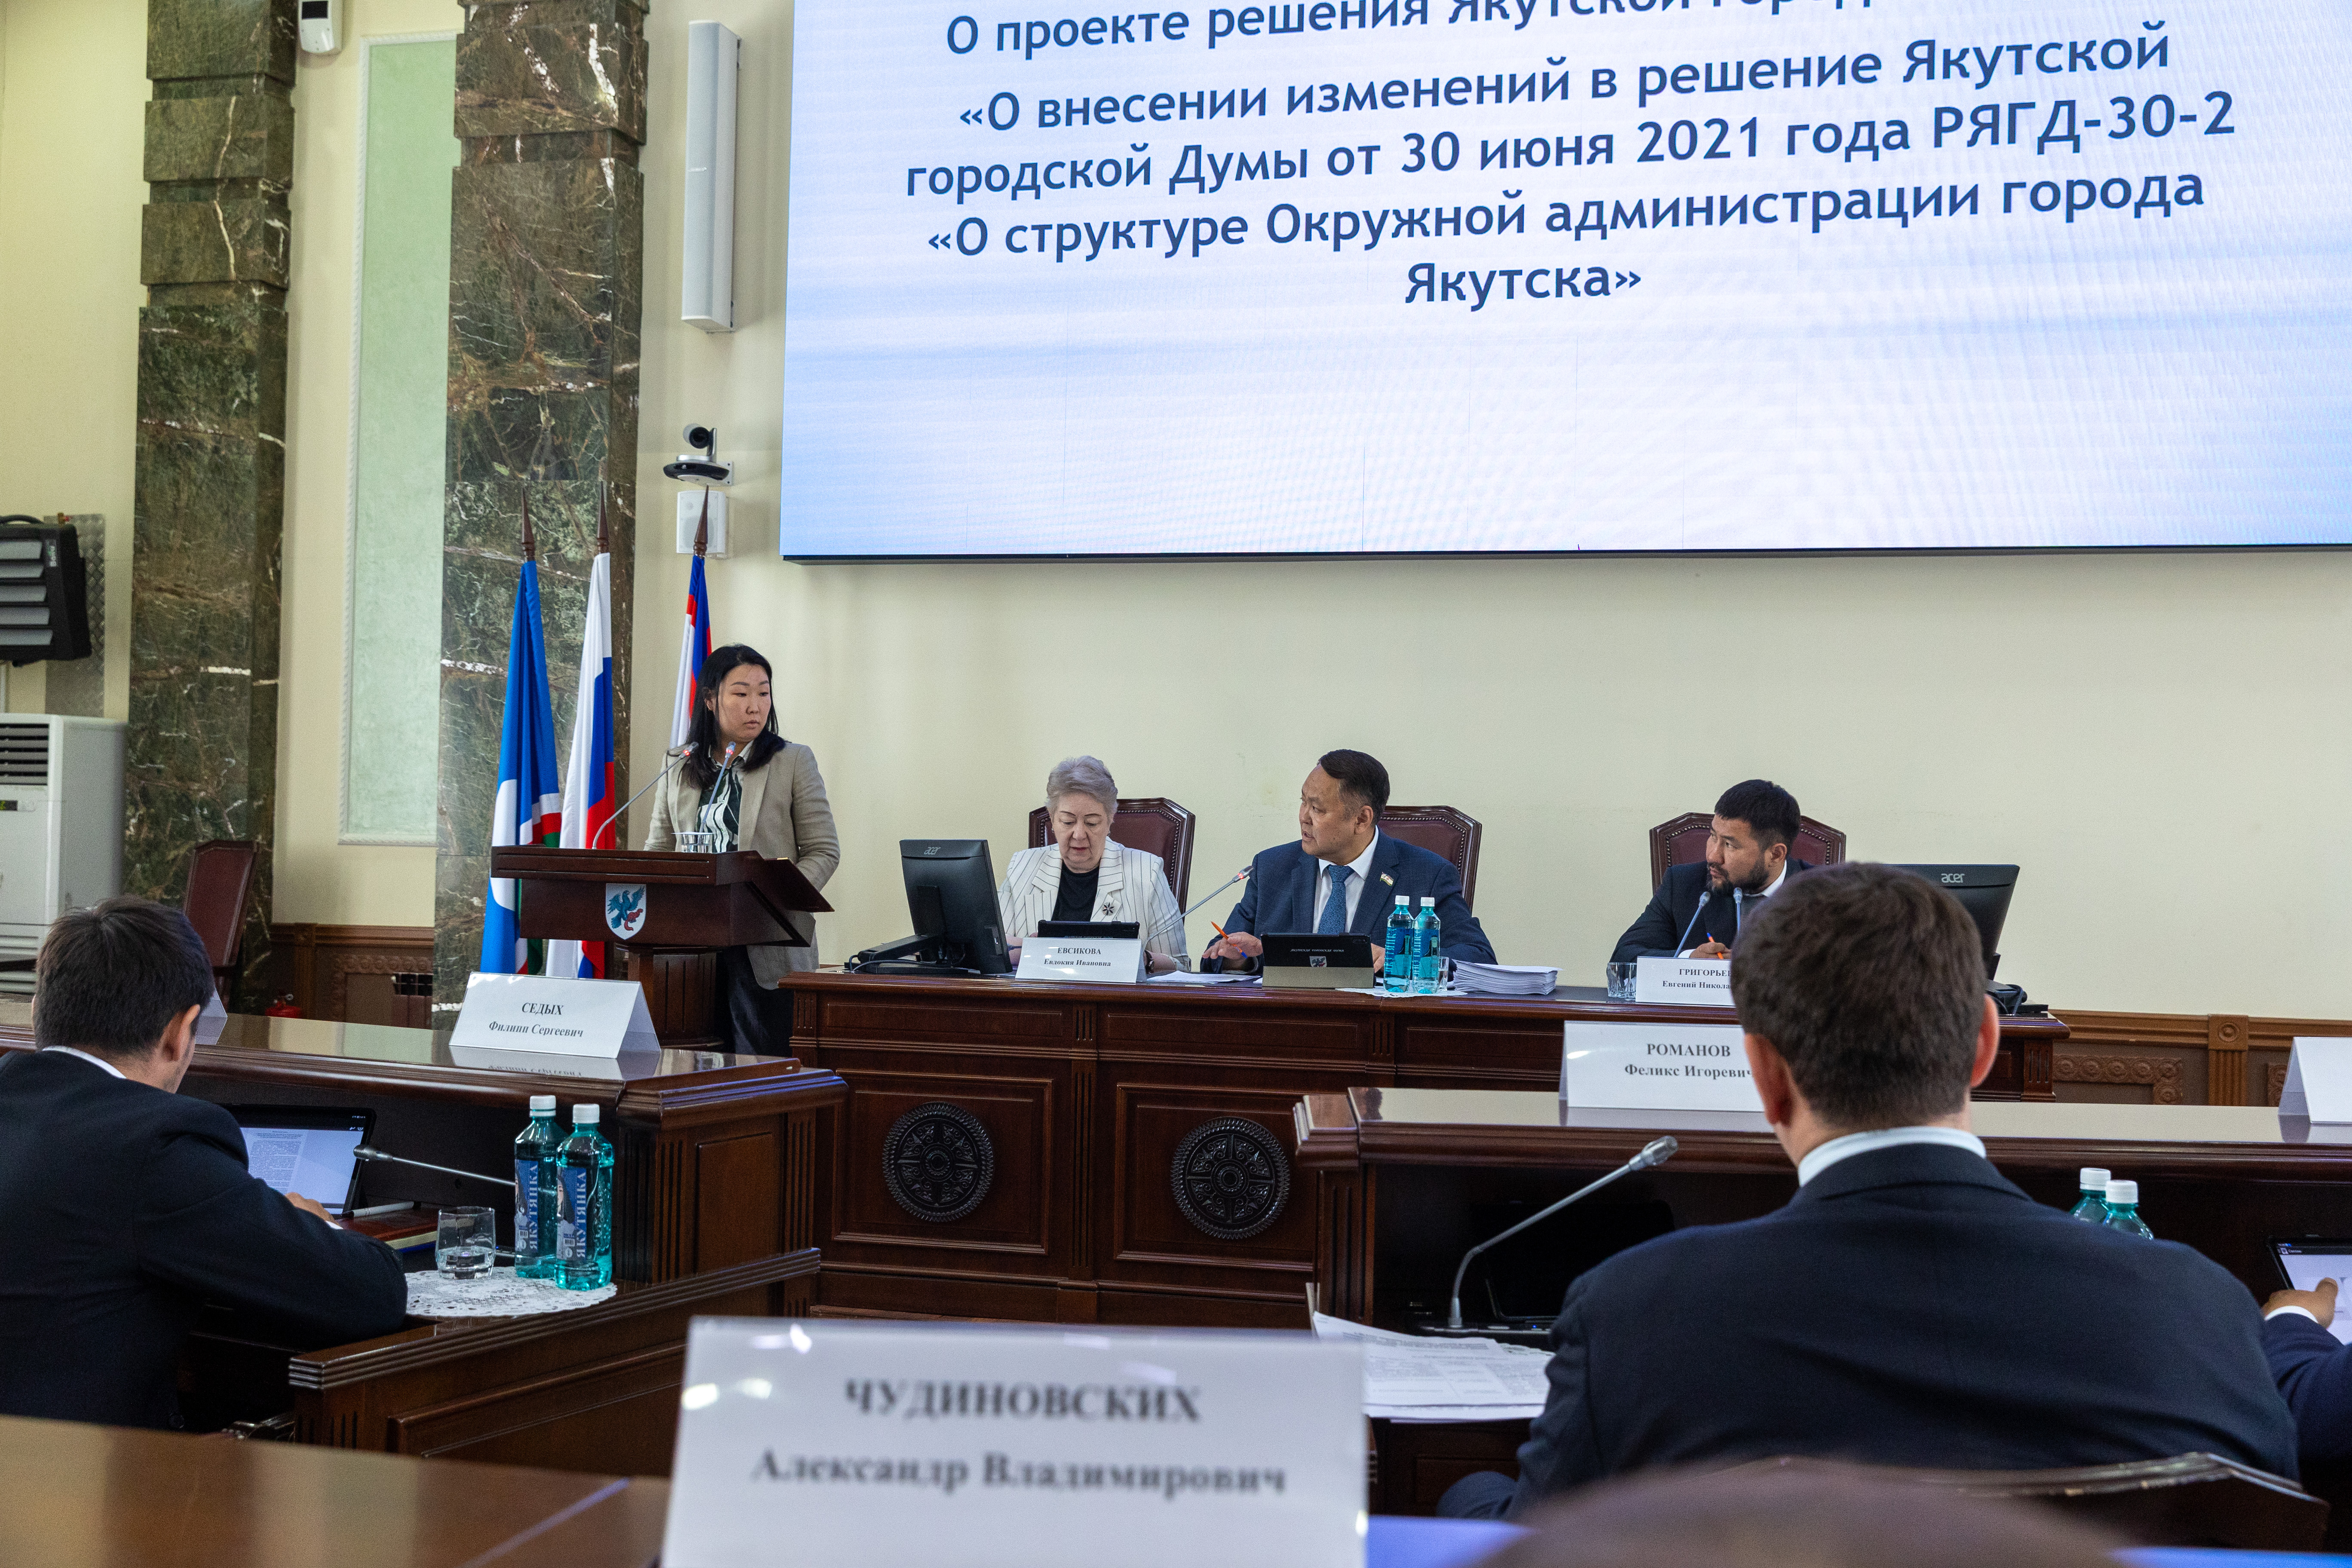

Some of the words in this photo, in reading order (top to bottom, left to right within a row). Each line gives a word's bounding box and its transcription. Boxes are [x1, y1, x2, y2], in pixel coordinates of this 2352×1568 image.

[946, 15, 979, 55] О
[996, 11, 1190, 61] проекте
[1208, 0, 1428, 50] решения
[959, 91, 1020, 132] «О
[1038, 87, 1267, 129] внесении
[1287, 56, 1569, 116] изменений
[1591, 68, 1617, 99] в
[1638, 53, 1883, 108] решение
[1902, 19, 2168, 90] Якутской
[907, 142, 1152, 205] городской
[1168, 144, 1308, 196] Думы
[1327, 144, 1381, 177] от
[1401, 131, 1460, 173] 30
[1480, 134, 1614, 171] июня
[1636, 116, 1757, 163] 2021
[1787, 119, 1911, 163] года
[1933, 90, 2235, 156] РЯГД-30-2
[928, 216, 989, 256] «О
[1005, 215, 1249, 263] структуре
[1267, 189, 1525, 252] Окружной
[1545, 183, 1979, 242] администрации
[2003, 174, 2205, 224] города
[1405, 262, 1642, 312] Якутска»
[924, 846, 941, 855] acer
[1941, 873, 1965, 883] acer
[488, 1021, 529, 1034] Филипп
[531, 1024, 584, 1038] Сергеевич
[521, 1002, 564, 1016] СЕДЫХ
[1624, 1064, 1680, 1076] Феликс
[1647, 1044, 1730, 1057] РОМАНОВ
[529, 1164, 538, 1250] ЯКУТЯНКА
[576, 1171, 586, 1258] ЯКУТЯНКА
[845, 1378, 1200, 1422] ЧУДИНОВСКИХ
[753, 1449, 970, 1496] Александр
[982, 1451, 1286, 1500] Владимирович
